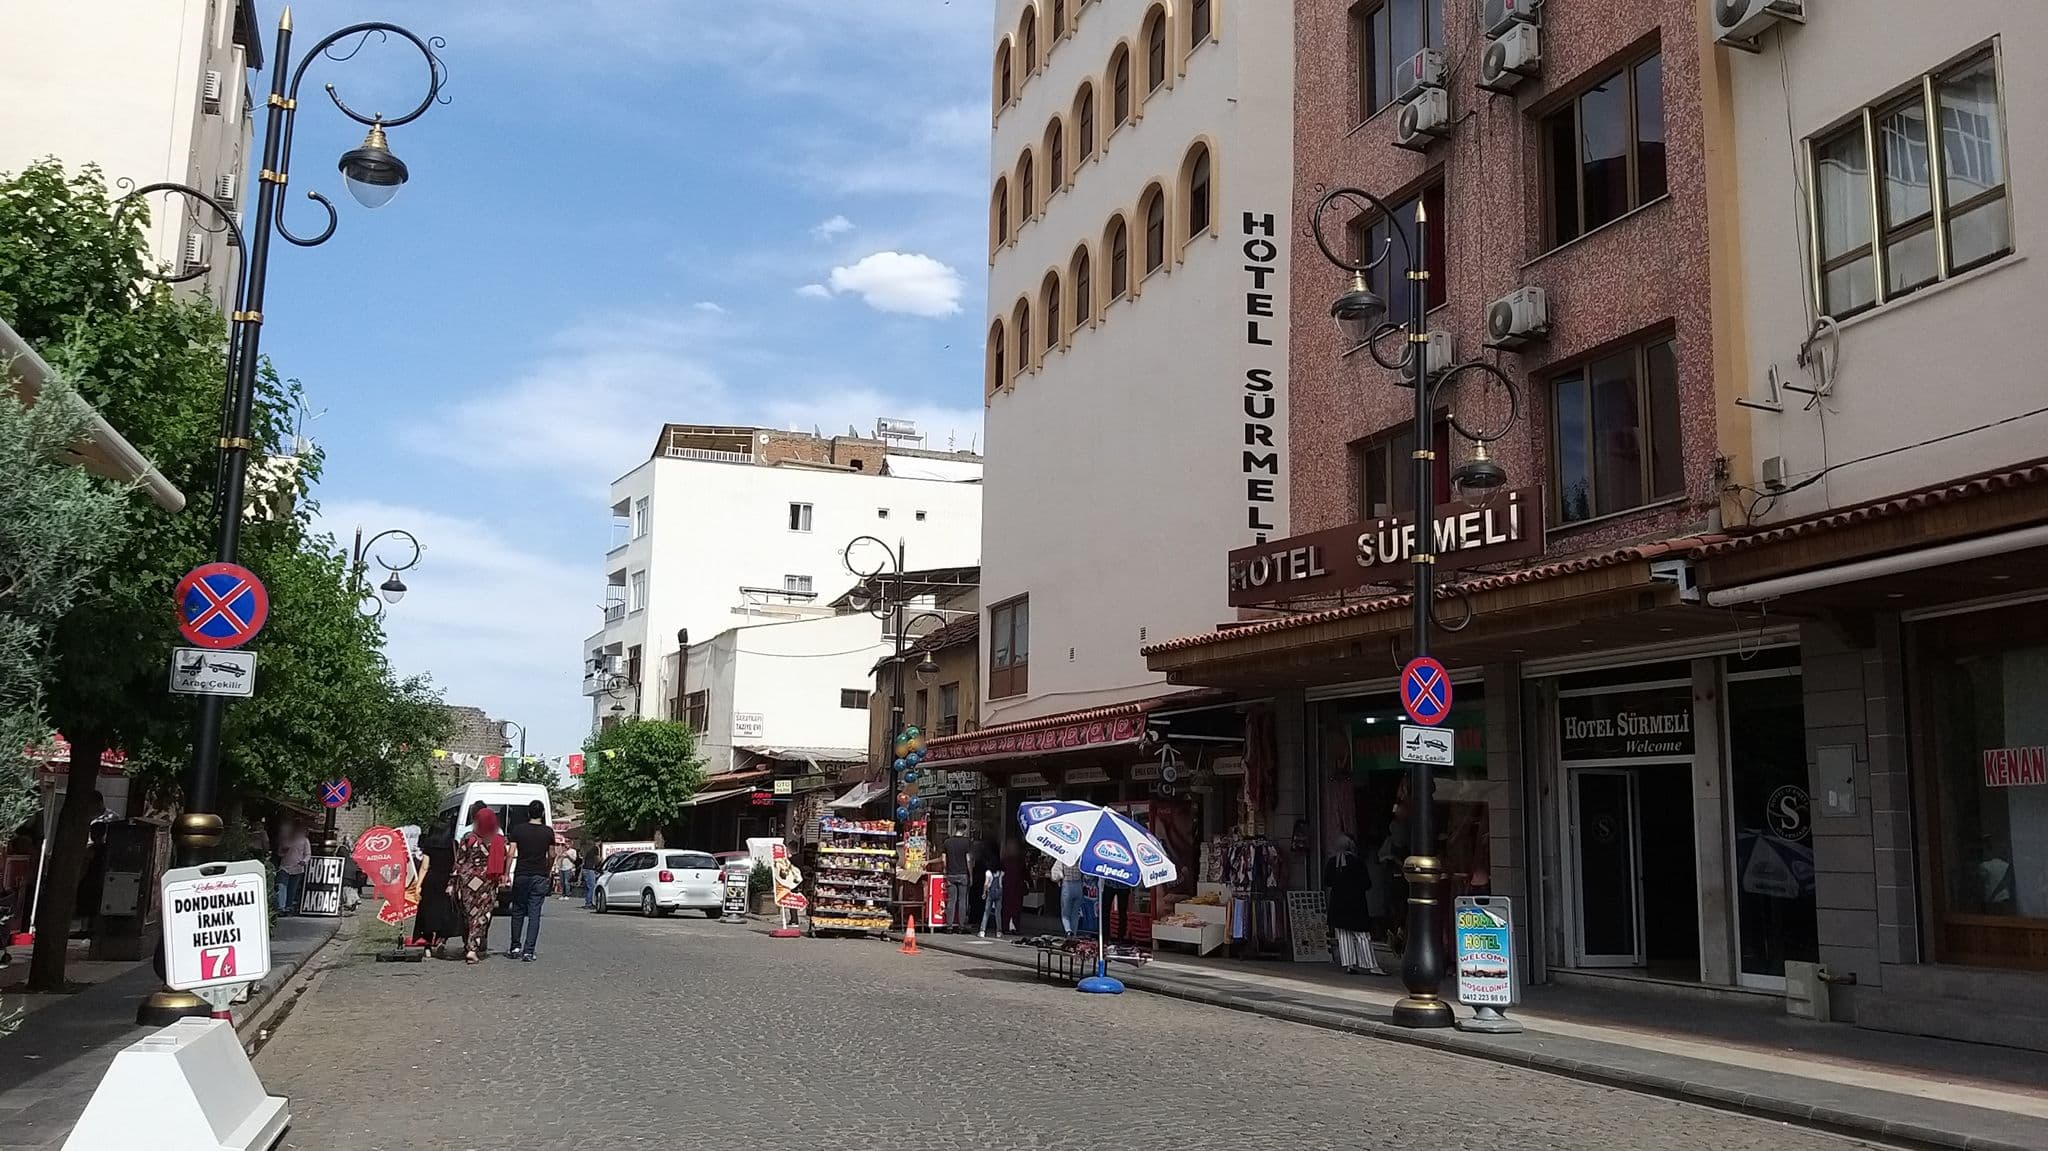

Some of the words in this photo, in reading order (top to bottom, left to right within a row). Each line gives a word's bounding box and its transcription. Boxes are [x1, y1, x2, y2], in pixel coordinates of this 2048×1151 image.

[1243, 212, 1277, 346] HOTEL
[1230, 546, 1326, 592] HOTEL
[182, 679, 206, 688] Araç
[209, 680, 242, 689] Çekilir
[1564, 716, 1614, 739] HOTEL
[1617, 709, 1690, 736] SÜRMELİ
[1626, 740, 1682, 753] Welcome
[1984, 747, 2046, 787] KENAN
[1036, 834, 1066, 855] alpedo
[307, 859, 340, 884] HOTEL
[1095, 864, 1130, 879] alpedo
[1149, 869, 1168, 881] alpedo
[174, 890, 255, 914] DONDURMALI
[303, 886, 338, 913] AKDAĞ
[198, 909, 235, 929] İRMİK
[193, 927, 241, 948] HELVASI
[1464, 934, 1501, 950] HOTEL
